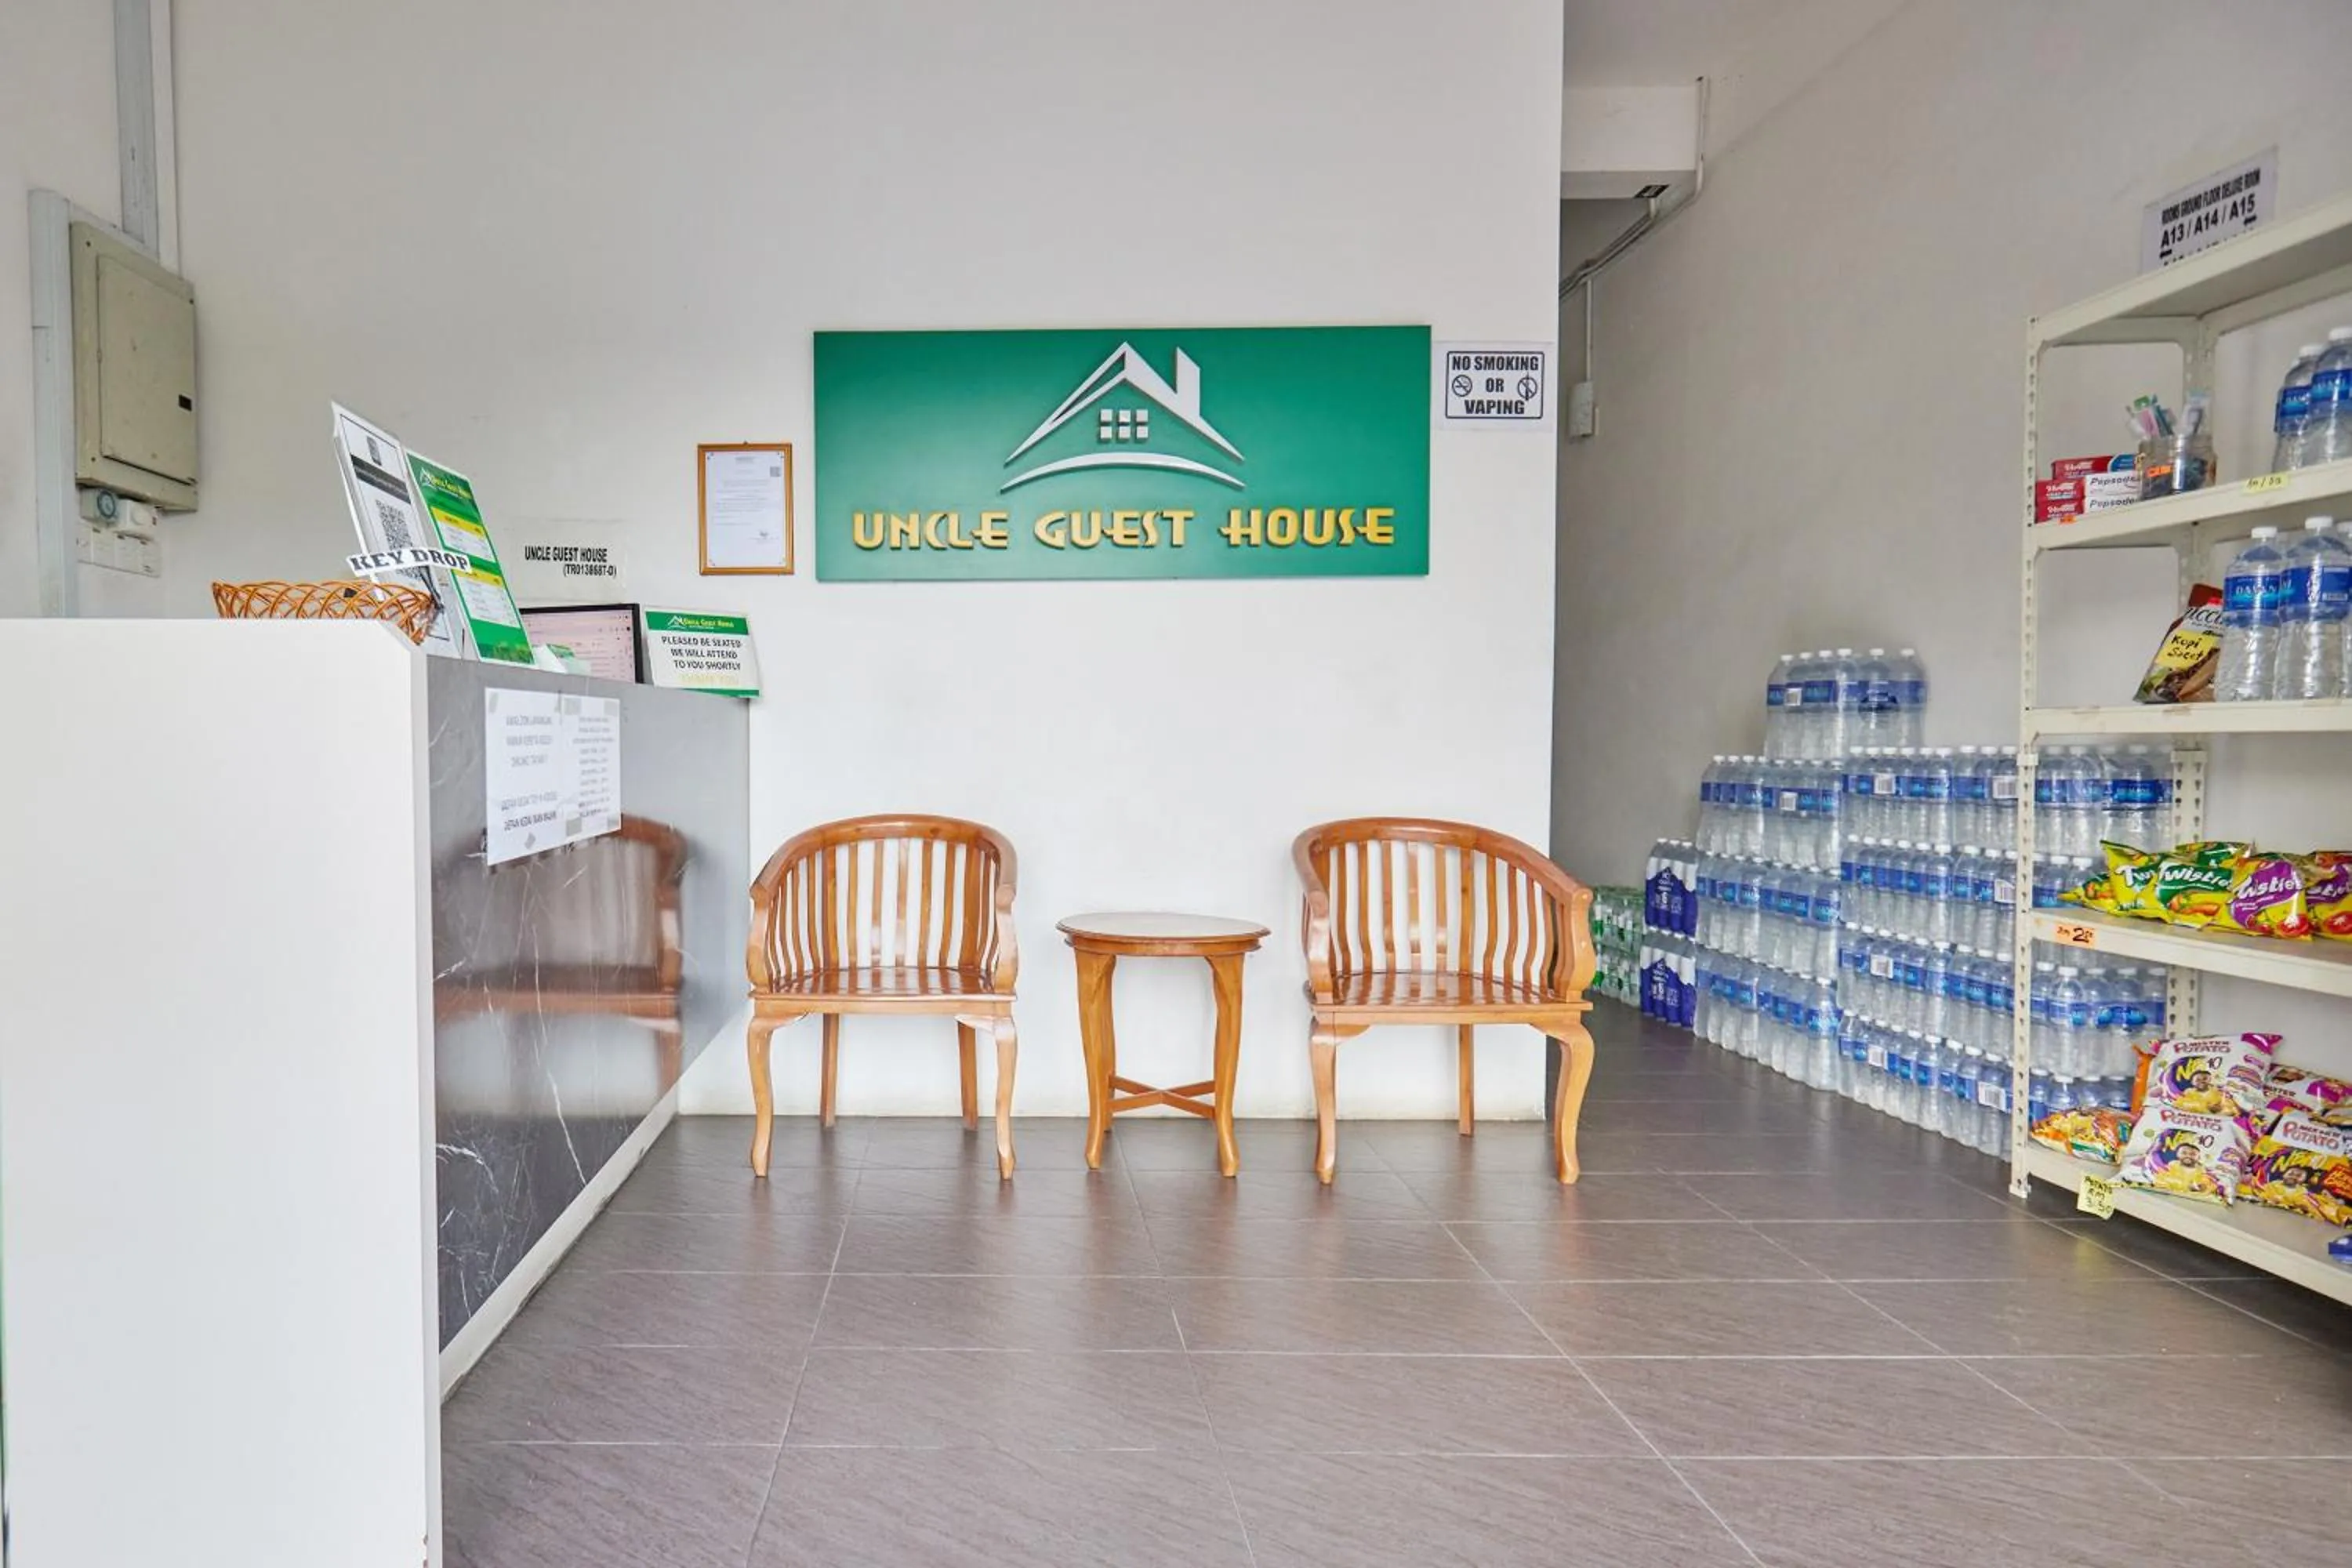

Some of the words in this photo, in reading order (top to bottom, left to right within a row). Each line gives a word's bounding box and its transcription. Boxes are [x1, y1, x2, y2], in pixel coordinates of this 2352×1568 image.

[2161, 223, 2185, 249] A13
[2194, 209, 2219, 235] A14
[2229, 194, 2256, 220] A15
[1452, 355, 1471, 371] NO
[1474, 355, 1539, 371] SMOKING
[1486, 377, 1504, 393] OR
[1464, 399, 1525, 415] VAPING
[852, 511, 1009, 550] UNCLE
[1033, 510, 1196, 549] GUEST
[1217, 507, 1396, 547] HOUSE
[350, 550, 405, 572] KEY
[410, 549, 469, 571] DROP
[524, 545, 551, 561] UNCLE
[553, 546, 579, 562] GUEST
[580, 547, 608, 563] HOUSE
[685, 649, 705, 658] WILL
[707, 650, 738, 659] ATTEND
[674, 660, 686, 669] TO
[687, 660, 704, 669] YOU
[706, 661, 741, 670] SHORTLY
[2158, 861, 2229, 887] Twistie
